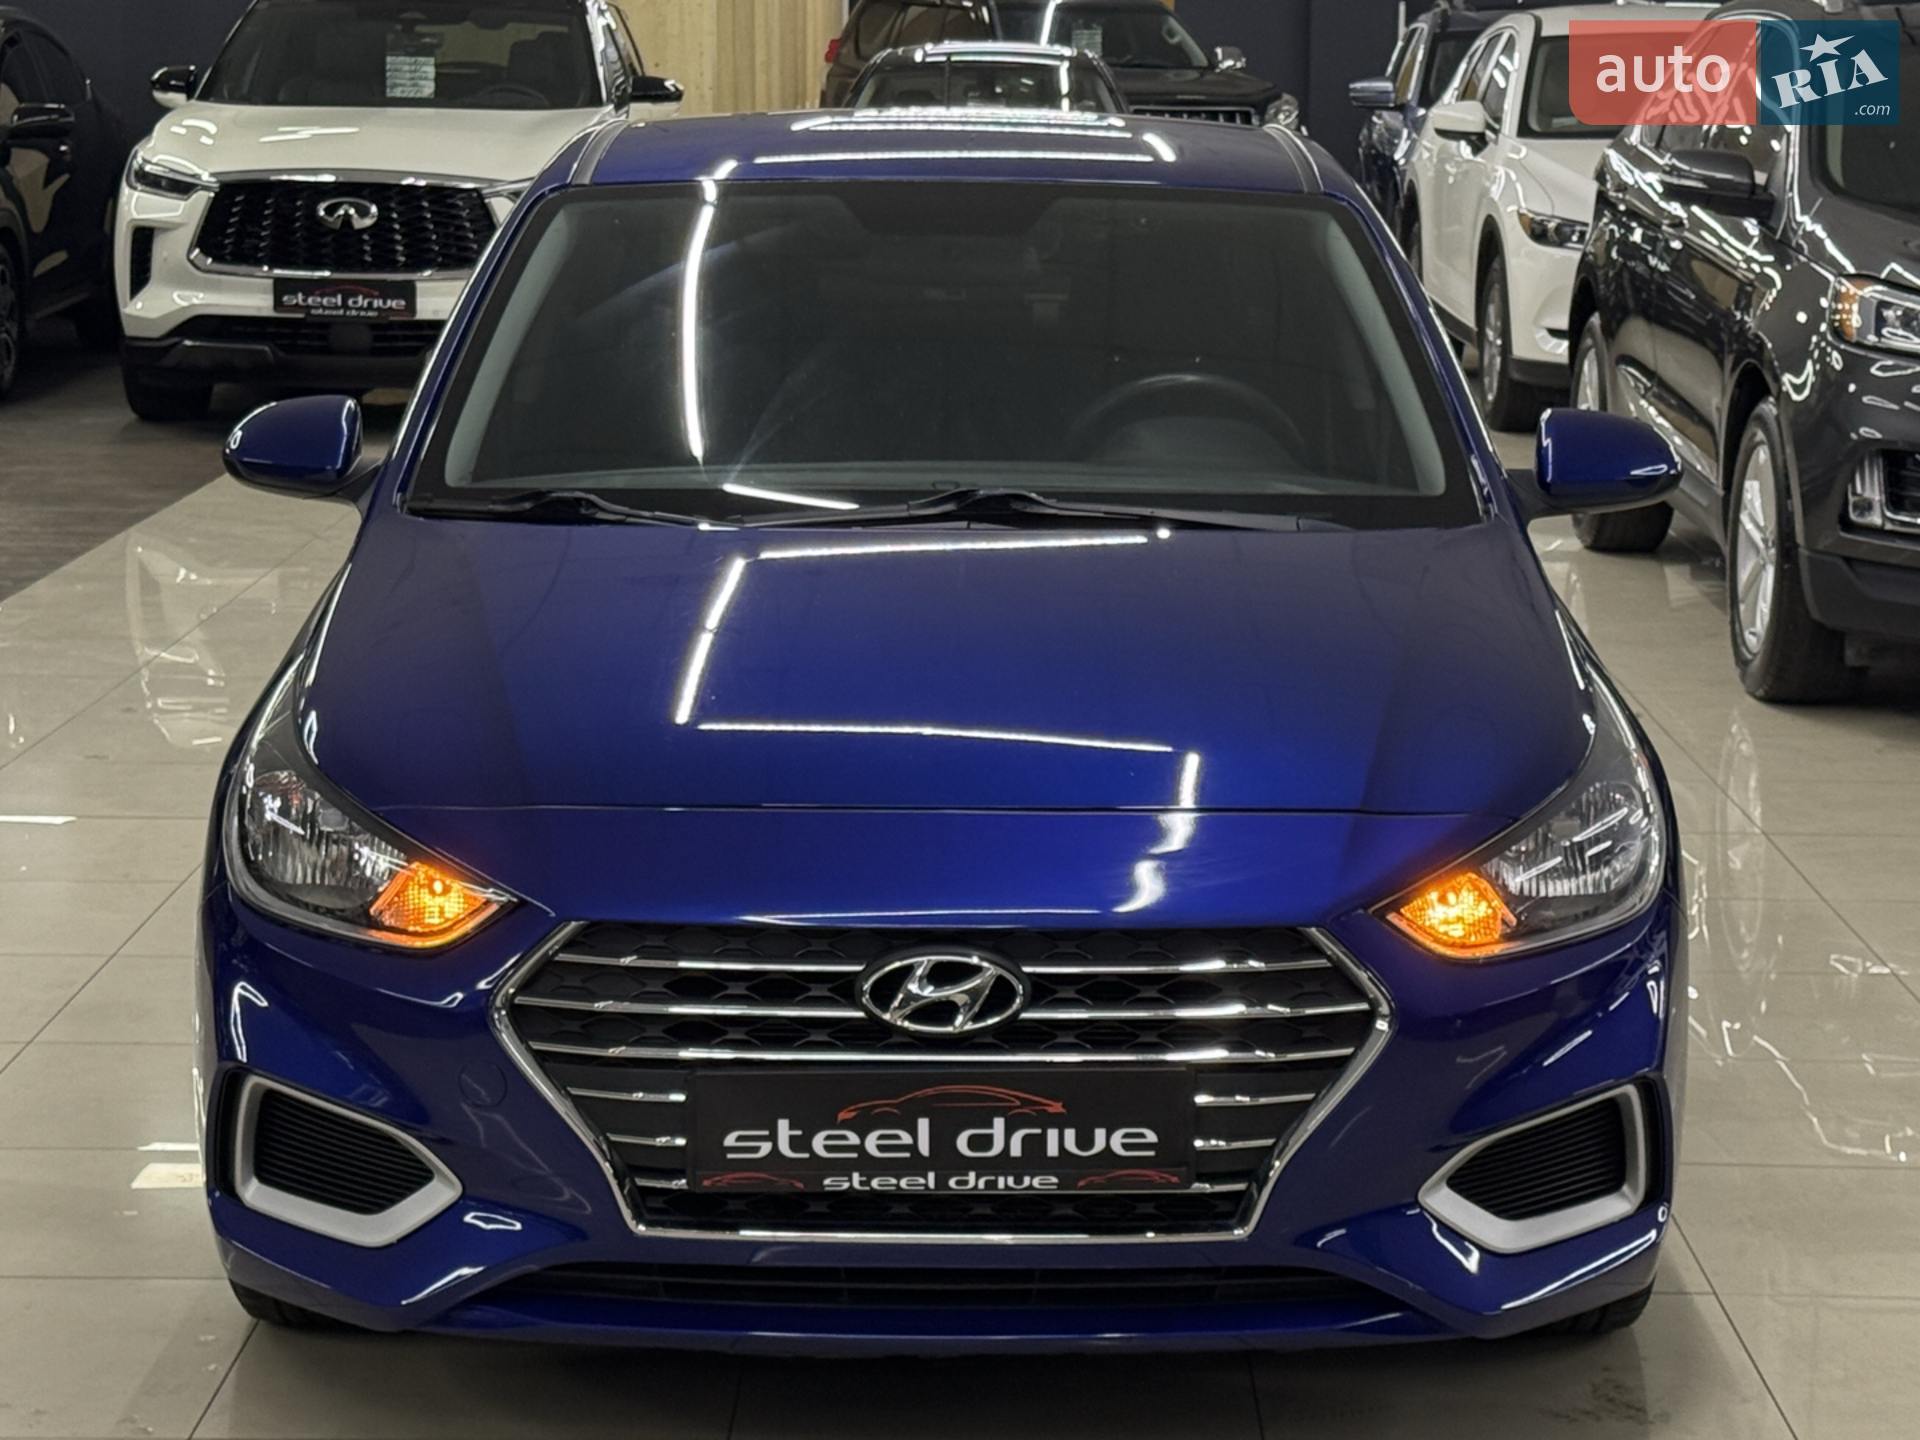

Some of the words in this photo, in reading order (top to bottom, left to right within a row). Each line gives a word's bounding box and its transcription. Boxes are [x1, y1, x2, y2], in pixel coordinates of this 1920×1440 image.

[282, 292, 342, 307] steel
[347, 294, 407, 310] drive
[723, 1117, 930, 1159] steel
[955, 1116, 1159, 1158] drive
[823, 1171, 936, 1191] steel
[948, 1171, 1059, 1190] drive
